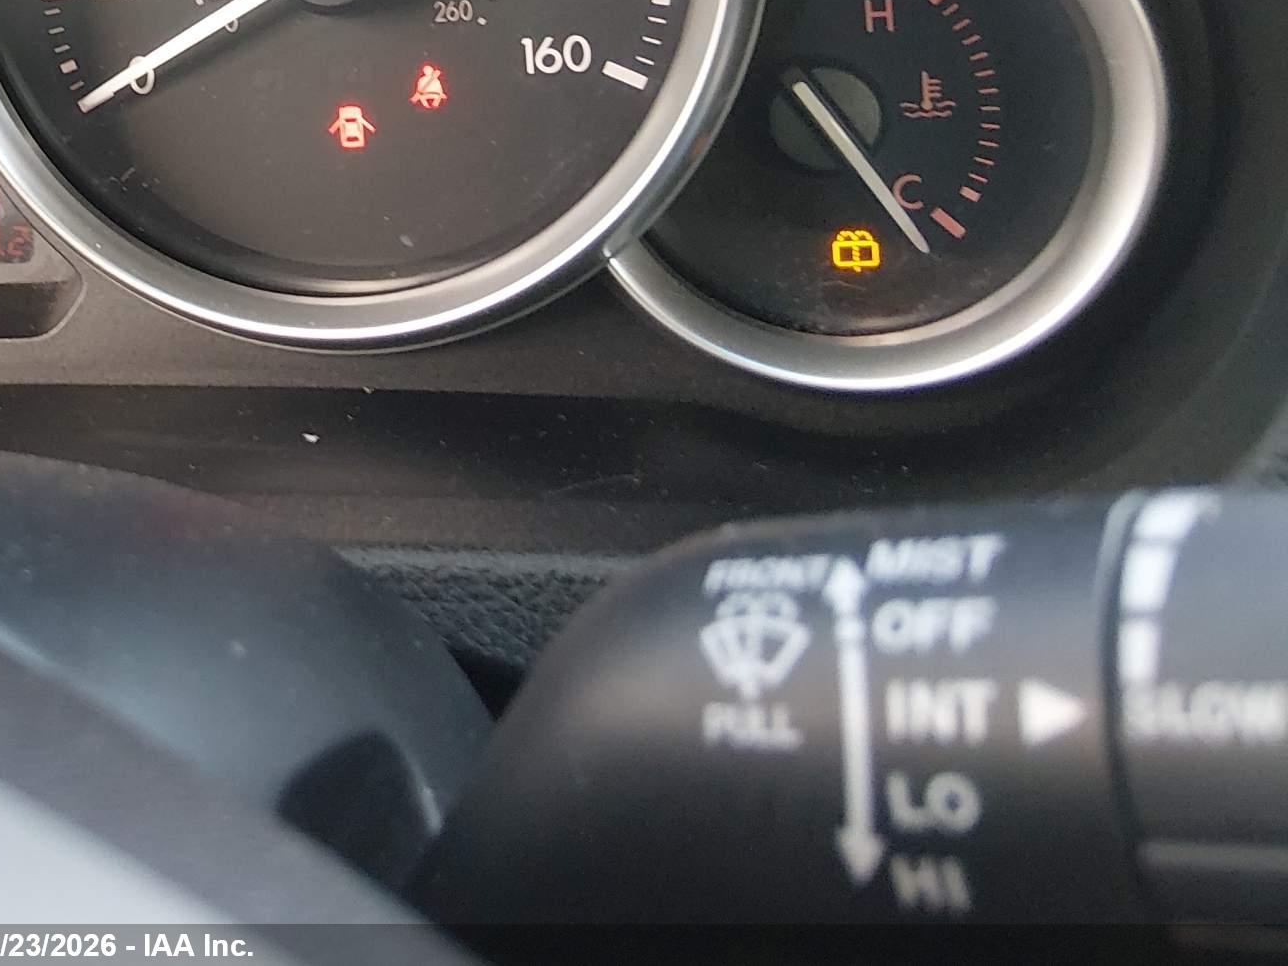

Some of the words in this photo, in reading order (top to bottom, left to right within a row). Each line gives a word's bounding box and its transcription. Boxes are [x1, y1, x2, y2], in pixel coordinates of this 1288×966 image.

[433, 0, 473, 24] 260
[520, 35, 591, 74] 160
[893, 174, 925, 211] C
[703, 554, 831, 594] FRONT
[865, 534, 1007, 583] MIST
[871, 597, 999, 654] OFF
[702, 701, 804, 750] PULL
[884, 678, 999, 744] INT
[1123, 679, 1288, 745] SLOW
[884, 770, 983, 833] LO
[888, 854, 974, 915] HI
